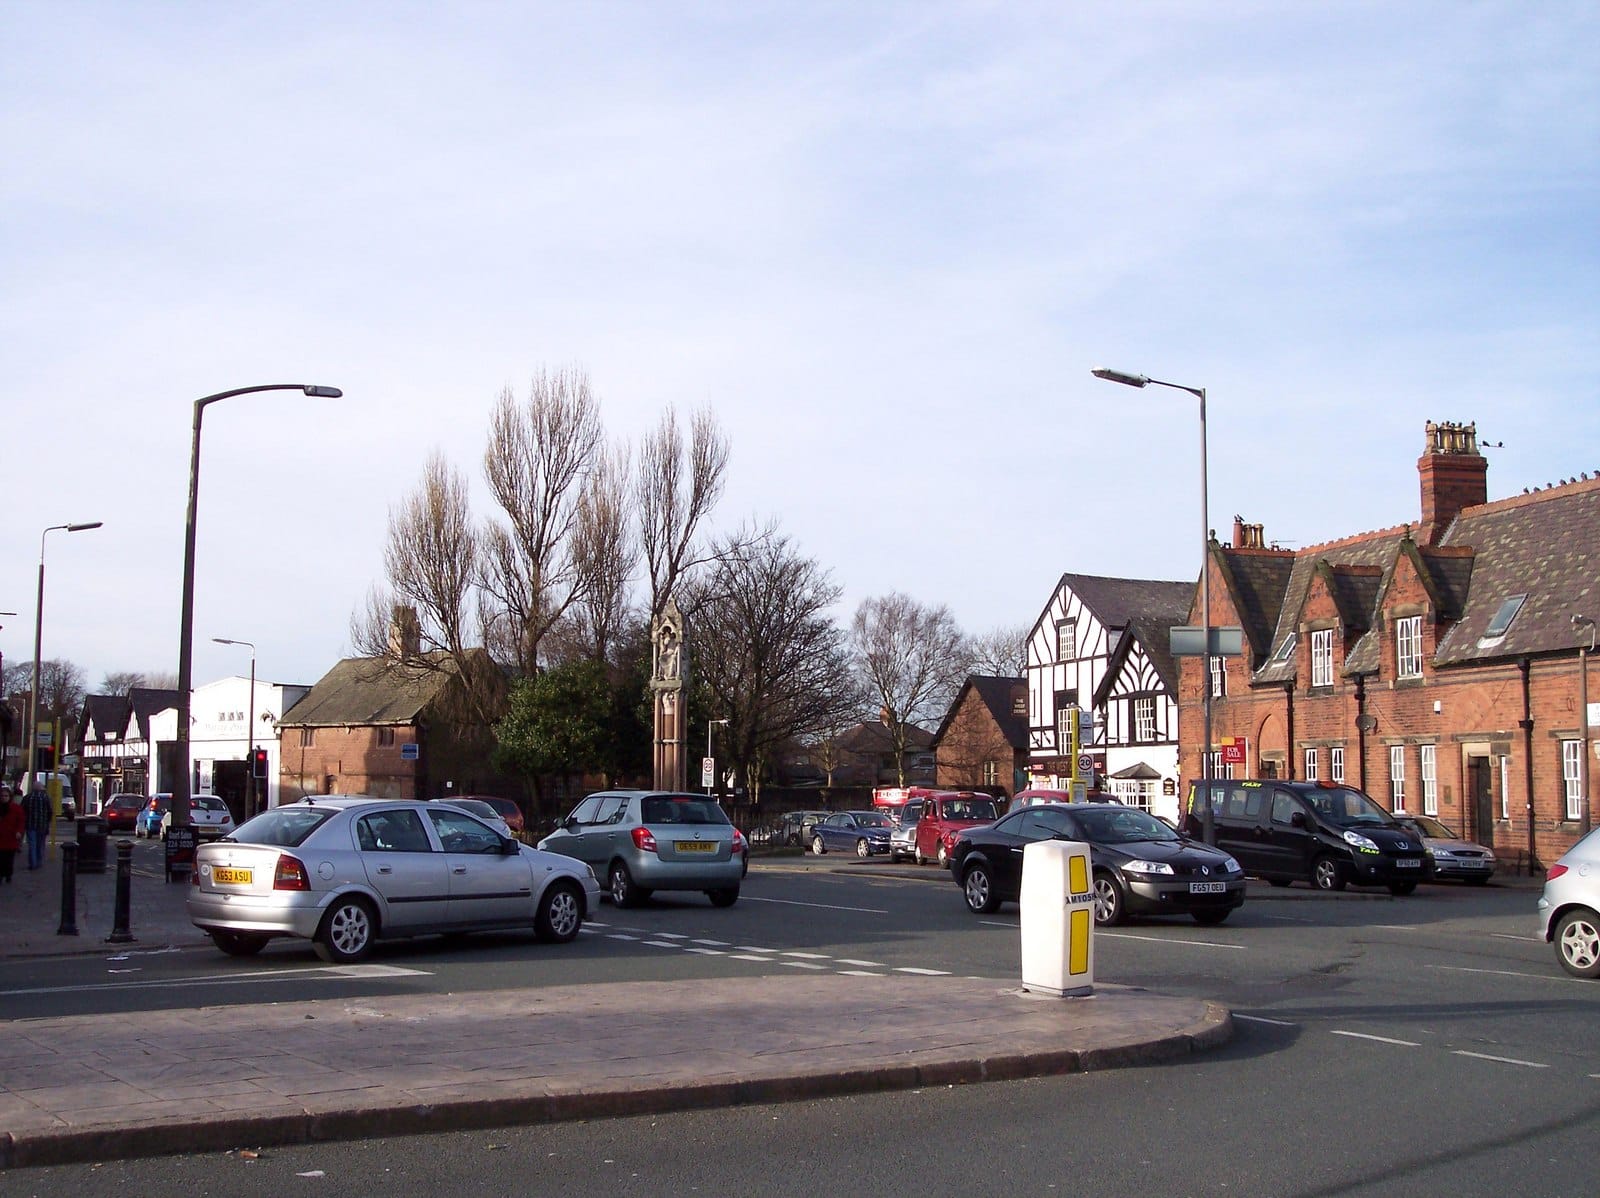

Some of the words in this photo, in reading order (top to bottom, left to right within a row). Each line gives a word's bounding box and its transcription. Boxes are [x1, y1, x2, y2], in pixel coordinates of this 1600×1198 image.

[1360, 847, 1379, 855] TAXI
[215, 871, 233, 881] KG53
[234, 872, 249, 882] ASU
[1192, 883, 1210, 892] FG57
